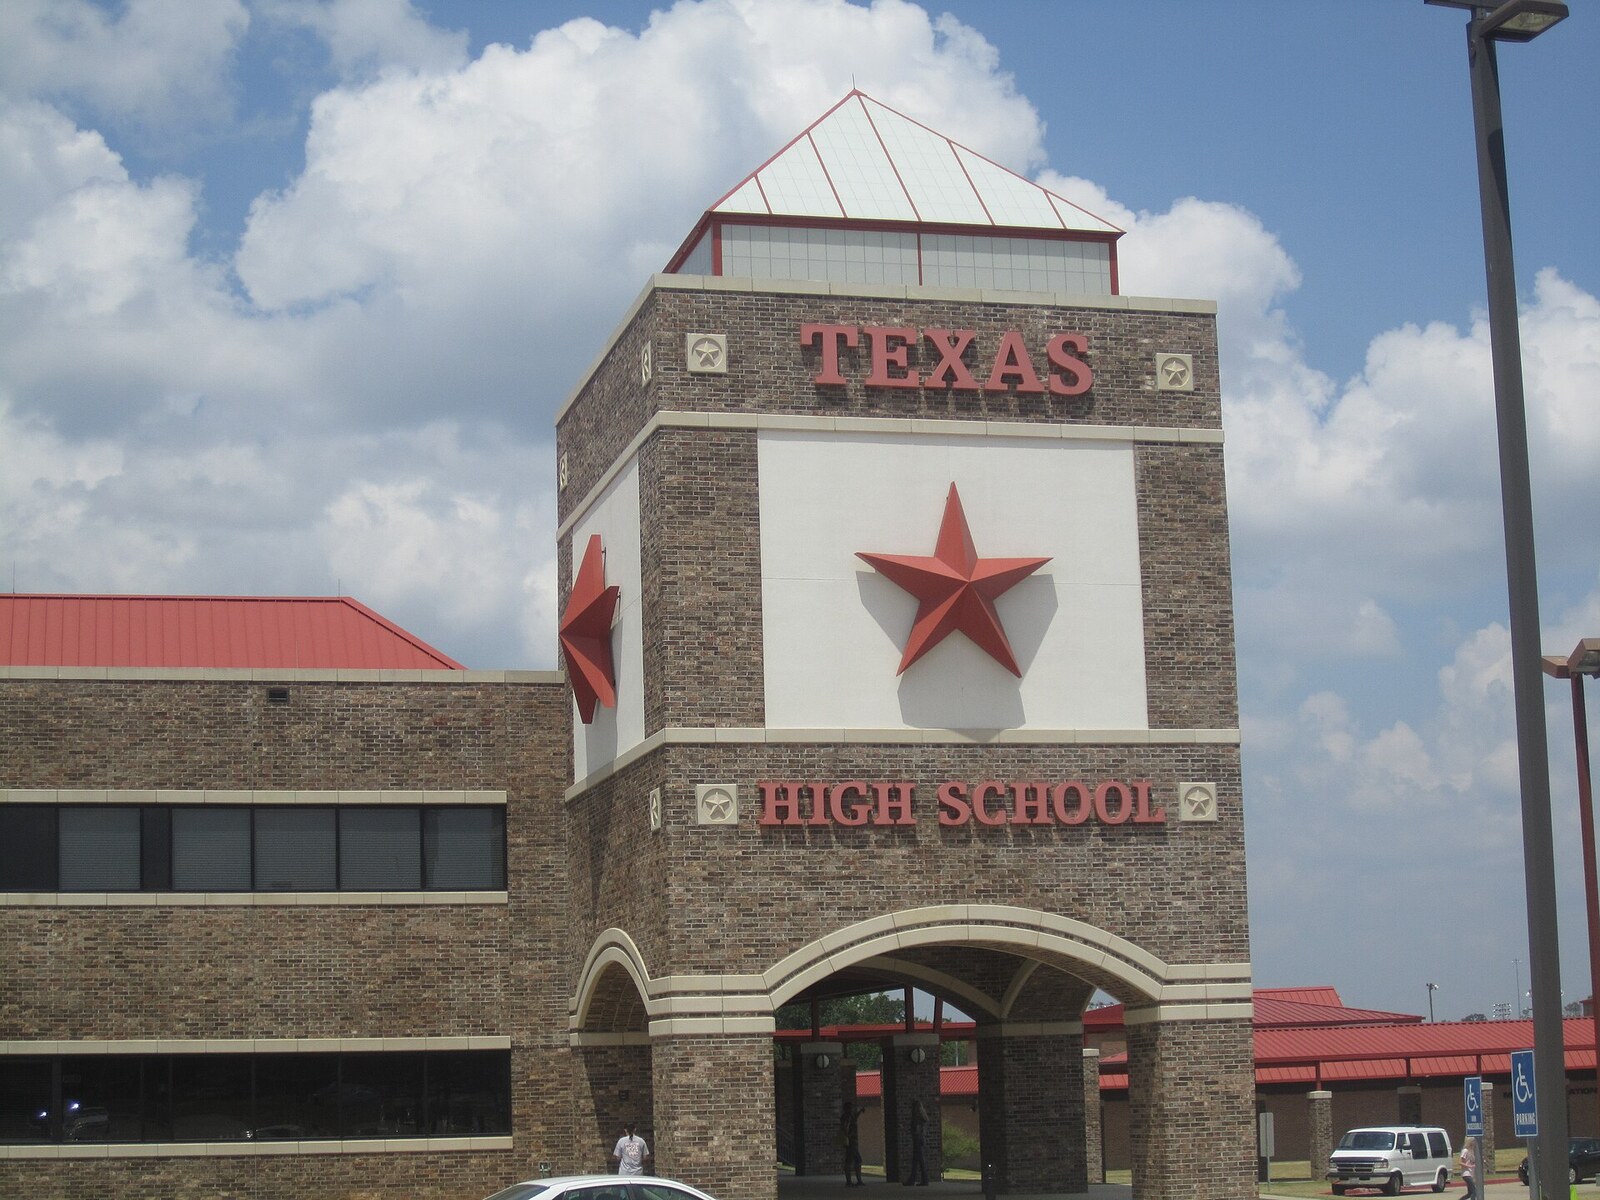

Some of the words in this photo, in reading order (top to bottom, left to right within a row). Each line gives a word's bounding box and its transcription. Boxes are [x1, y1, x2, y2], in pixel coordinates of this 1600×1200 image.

[800, 324, 1093, 396] TEXAS
[758, 781, 917, 826] HIGH
[937, 781, 1166, 826] SCHOOL
[1516, 1112, 1536, 1126] PARKING
